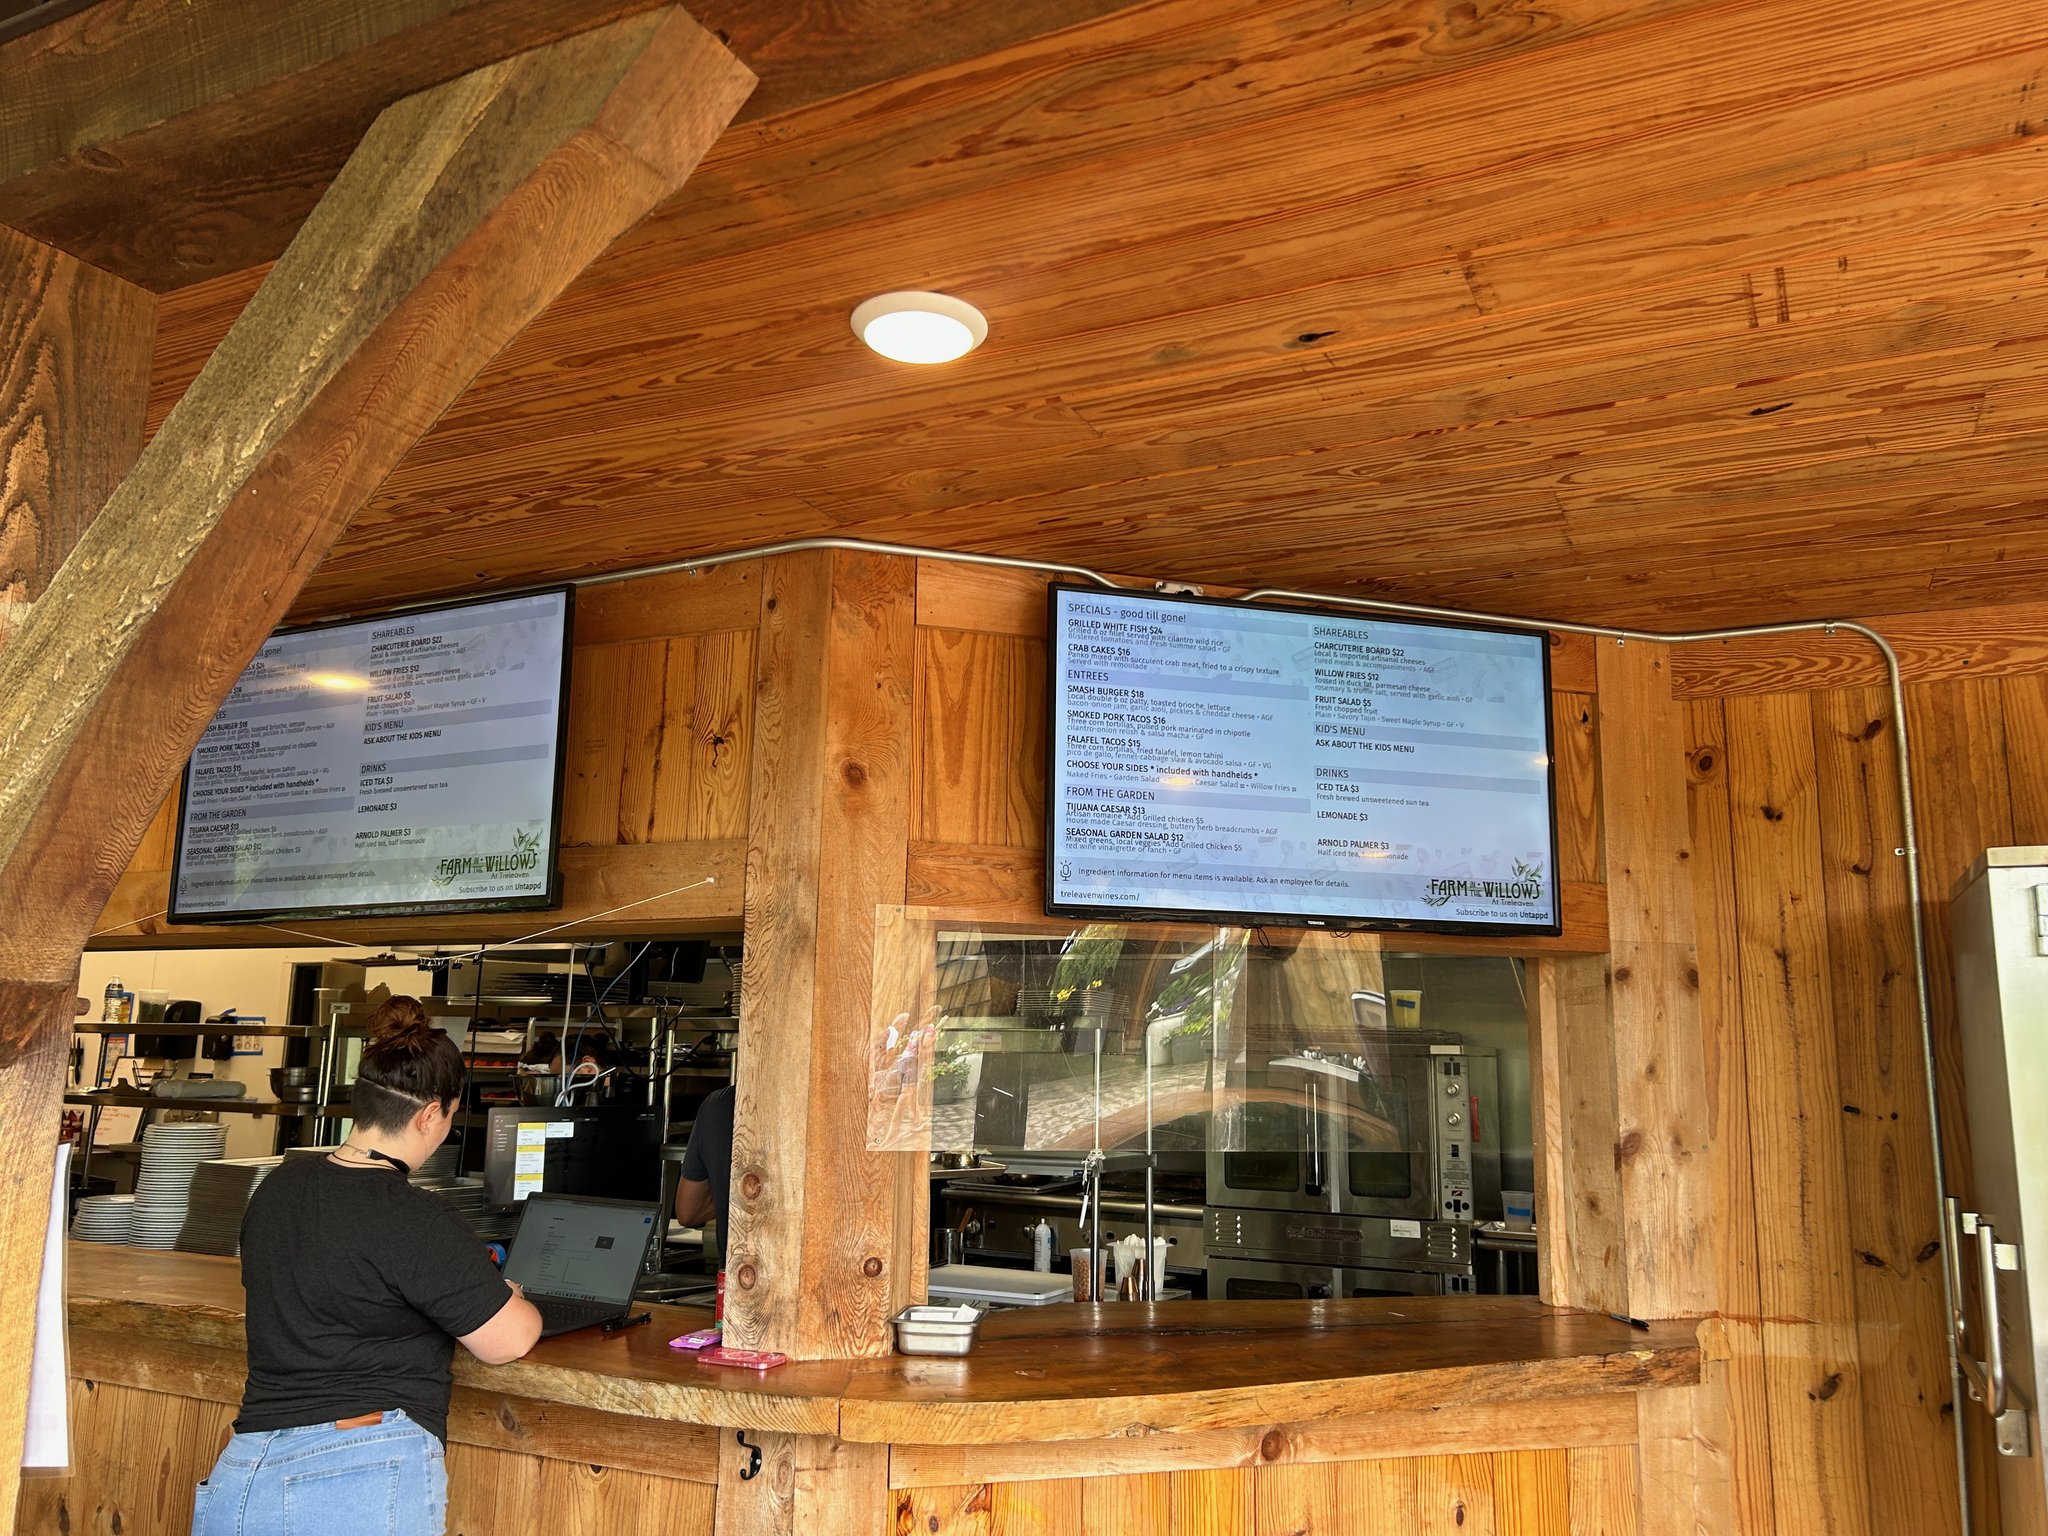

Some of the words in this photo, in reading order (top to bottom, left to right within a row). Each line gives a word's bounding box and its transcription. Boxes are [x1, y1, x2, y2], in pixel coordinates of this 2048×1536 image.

[1068, 603, 1111, 615] SPECIALS
[1120, 608, 1143, 620] good
[1146, 611, 1158, 620] till
[1160, 612, 1185, 624] gone!
[372, 625, 415, 639] SHAREABLES
[1068, 619, 1101, 628] GRILLED
[1102, 622, 1127, 631] WHITE
[1130, 624, 1147, 633] FISH
[1149, 625, 1162, 635] $24
[1313, 626, 1368, 639] SHAREABLES
[371, 640, 409, 652] CHARCUTERIE
[410, 637, 431, 646] BOARD
[431, 635, 442, 644] $22
[1067, 643, 1089, 652] CRAB
[1090, 645, 1115, 654] CAKES
[1117, 647, 1130, 656] $16
[1314, 641, 1363, 652] CHARCUTERIE
[1365, 646, 1390, 655] BOARD
[1391, 648, 1404, 657] $22
[1314, 649, 1331, 657] Local
[1339, 652, 1369, 662] imported
[1370, 654, 1398, 663] artisanal
[1399, 657, 1425, 665] cheeses
[368, 668, 392, 678] WILLOW
[392, 666, 409, 674] FRIES
[1067, 669, 1108, 681] ENTREES
[1314, 668, 1344, 677] WILLOW
[1345, 671, 1366, 679] FRIES
[1367, 672, 1379, 681] $12
[384, 692, 403, 701] SALAD
[1067, 685, 1094, 694] SMASH
[1097, 687, 1129, 696] BURGER
[1130, 689, 1144, 698] $18
[1315, 695, 1336, 703] FRUIT
[1337, 697, 1361, 705] SALAD
[1362, 699, 1371, 707] $5
[1333, 705, 1362, 715] chopped
[1067, 710, 1100, 719] SMOKED
[1102, 712, 1124, 721] PORK
[1126, 714, 1151, 723] TACOS
[1152, 715, 1166, 725] $16
[364, 722, 382, 731] KID'S
[383, 720, 403, 729] MENU
[1105, 720, 1135, 729] tortillas,
[1136, 722, 1159, 731] pulled
[1160, 724, 1176, 733] pork
[1178, 725, 1213, 734] marinated
[1223, 729, 1250, 738] chipotle
[1315, 724, 1337, 733] KID'S
[1339, 726, 1365, 735] MENU
[375, 735, 395, 743] ABOUT
[396, 733, 407, 741] THE
[423, 730, 441, 738] MENU
[1067, 735, 1099, 744] FALAFEL
[1101, 737, 1126, 745] TACOS
[1127, 738, 1140, 747] $15
[196, 746, 218, 754] SMOKED
[233, 742, 250, 750] TACOS
[1331, 740, 1357, 748] ABOUT
[1374, 743, 1391, 751] KIDS
[1393, 745, 1414, 753] MENU
[194, 767, 215, 775] FALAFEL
[232, 764, 242, 772] $15
[361, 763, 386, 773] DRINKS
[1066, 760, 1099, 769] CHOOSE
[1101, 762, 1123, 770] YOUR
[1125, 764, 1148, 772] SIDES
[1156, 766, 1190, 775] included
[1192, 768, 1209, 776] with
[1211, 769, 1252, 779] handhelds
[1316, 768, 1349, 778] DRINKS
[359, 778, 373, 786] ICED
[373, 777, 385, 785] TEA
[385, 776, 393, 784] $3
[1066, 786, 1093, 796] FROM
[1096, 788, 1114, 797] THE
[1116, 789, 1154, 800] GARDEN
[1350, 784, 1359, 793] $3
[1335, 794, 1359, 802] brewed
[1361, 796, 1404, 804] unsweetened
[357, 804, 389, 812] LEMONADE
[389, 802, 397, 810] $3
[1065, 802, 1098, 813] TIJUANA
[1100, 804, 1130, 813] CAESAR
[1132, 806, 1145, 815] $13
[190, 812, 207, 821] FROM
[208, 811, 220, 819] THE
[221, 808, 246, 818] GARDEN
[1316, 811, 1357, 820] LEMONADE
[1359, 813, 1368, 821] $3
[355, 831, 379, 839] ARNOLD
[379, 829, 403, 837] PALMER
[403, 828, 411, 836] $3
[1065, 827, 1107, 837] SEASONAL
[1109, 830, 1142, 838] GARDEN
[1144, 832, 1169, 840] SALAD
[1171, 833, 1183, 841] $12
[1317, 839, 1348, 847] ARNOLD
[1349, 840, 1378, 848] PALMER
[1380, 841, 1389, 850] $3
[1347, 850, 1360, 858] tea,
[439, 857, 472, 874] FARM
[1078, 868, 1115, 877] Ingredient
[1116, 869, 1158, 878] information
[1279, 878, 1312, 887] employee
[514, 881, 541, 890] Untappd
[1431, 878, 1467, 896] FARM
[1060, 890, 1139, 901] treleavenwines.com/
[1501, 898, 1534, 906] Treleaven
[1455, 908, 1489, 916] Subscribe
[1519, 911, 1548, 920] Untappd
